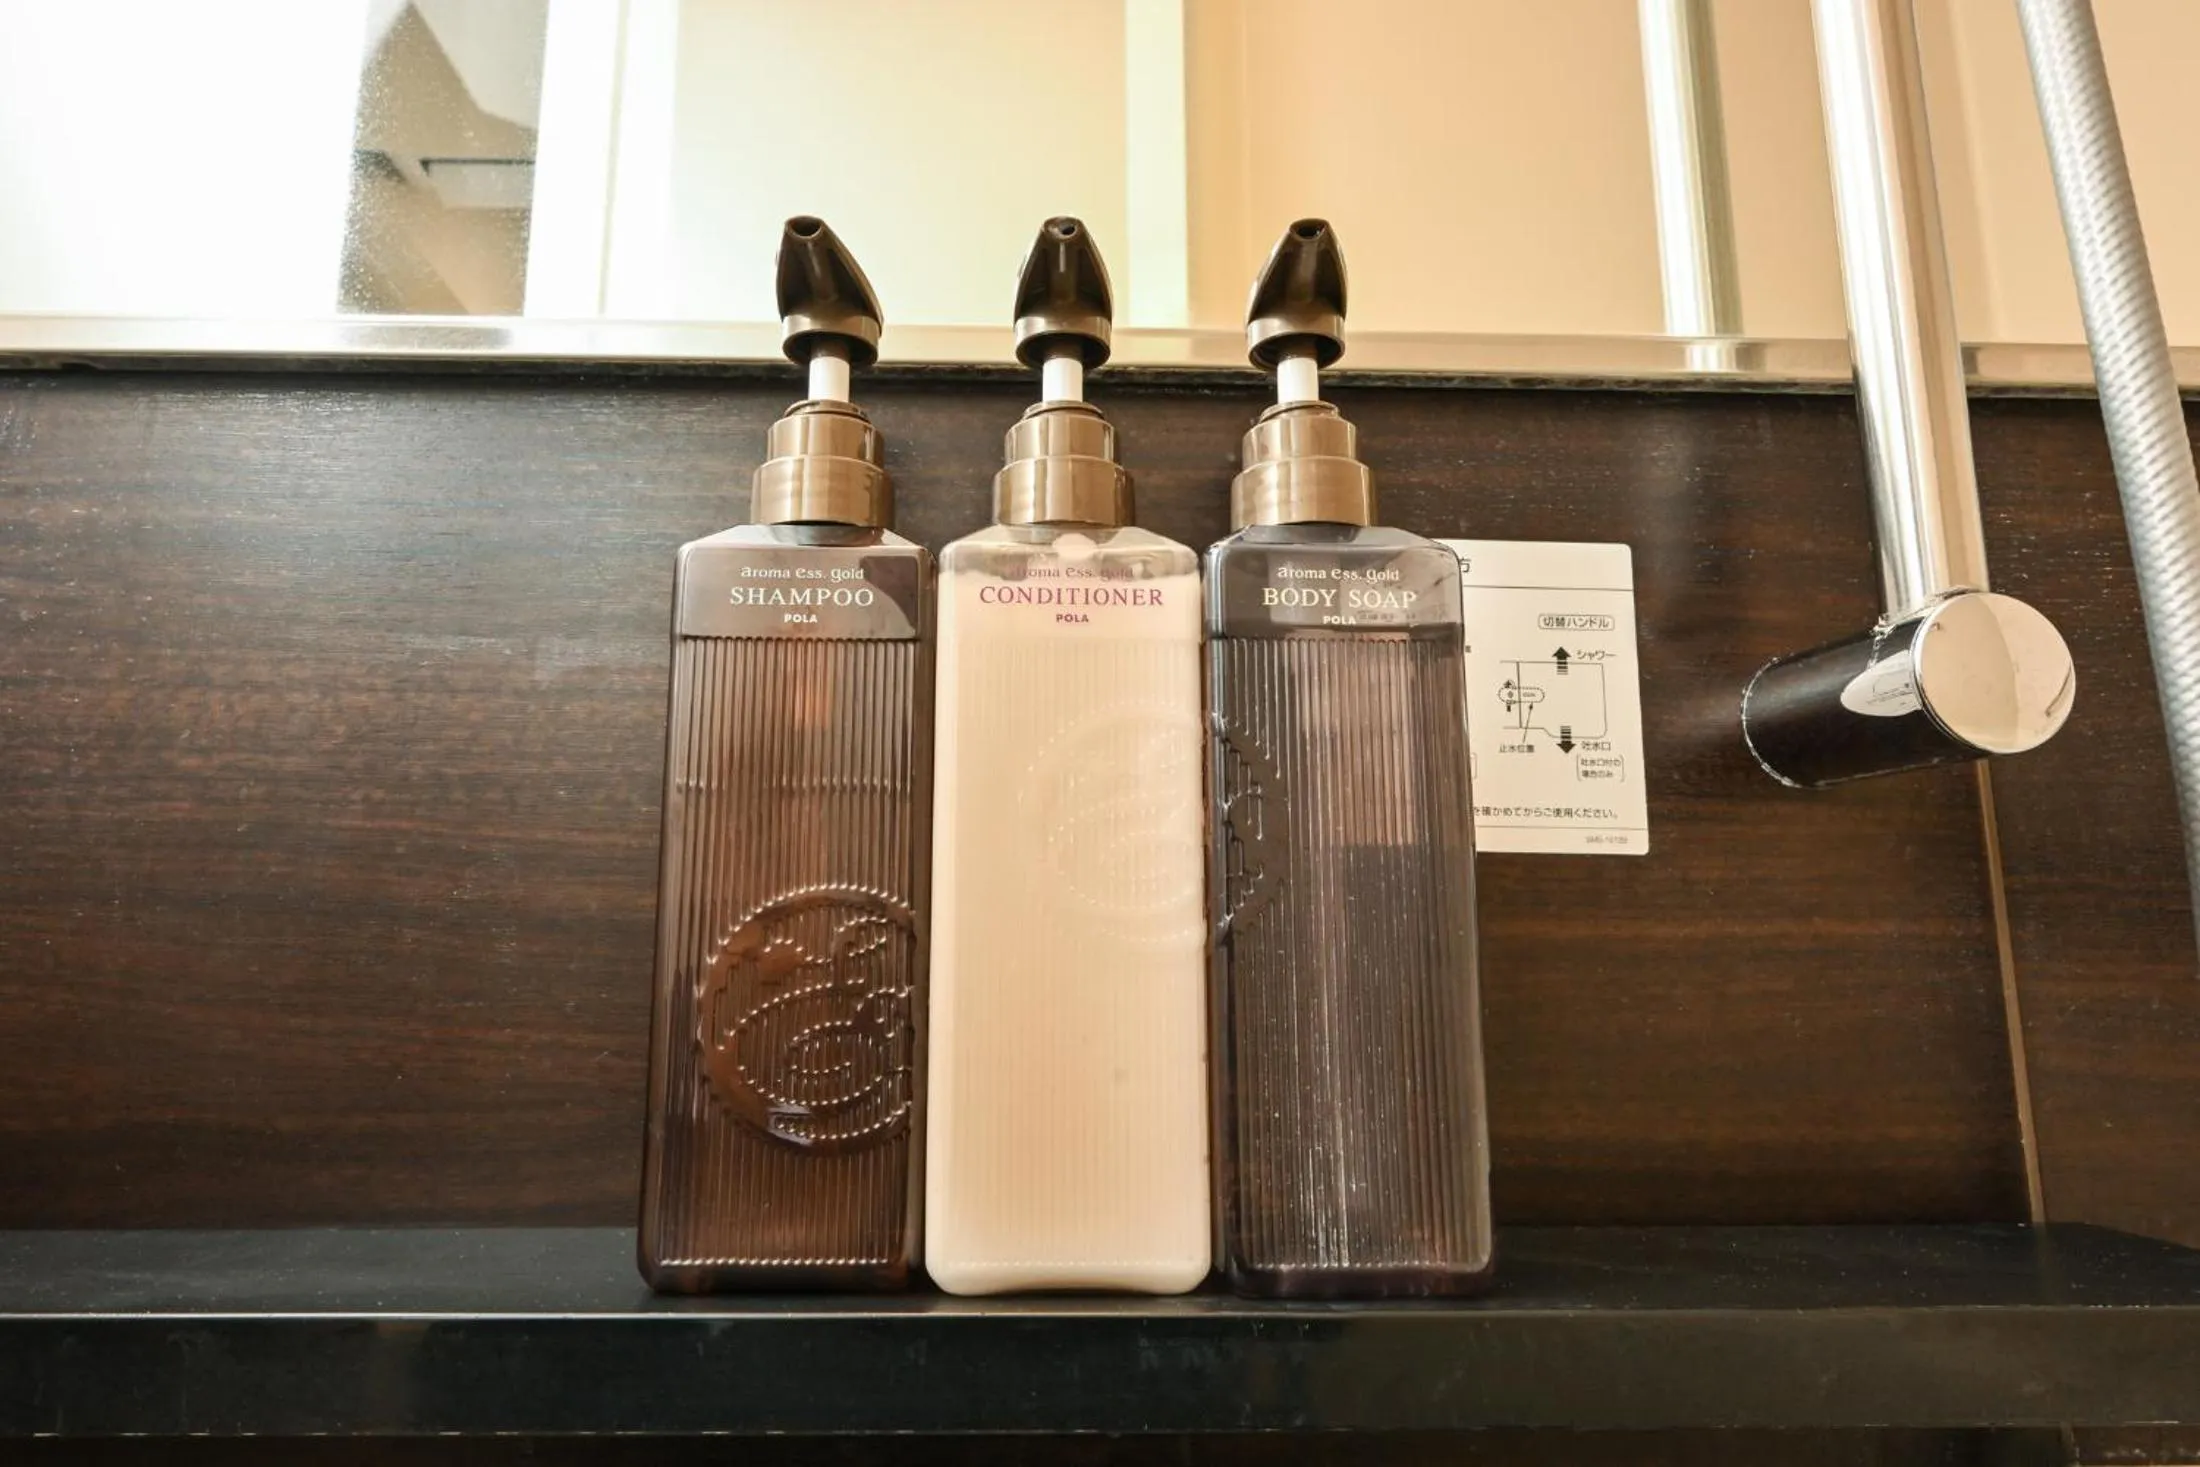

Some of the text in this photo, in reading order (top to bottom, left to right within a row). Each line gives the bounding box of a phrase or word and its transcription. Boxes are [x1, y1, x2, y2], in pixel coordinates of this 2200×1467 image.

[741, 566, 790, 579] aroma
[830, 567, 864, 583] gold
[1010, 566, 1060, 578] aroma
[1277, 567, 1326, 579] aroma
[1366, 569, 1399, 583] gold
[730, 586, 874, 607] SHAMPOO
[979, 586, 1164, 606] CONDITIONER
[1262, 587, 1418, 609] BODY SOAP
[783, 613, 818, 624] POLA
[1056, 614, 1089, 623] POLA
[1323, 615, 1357, 625] POLA
[1543, 616, 1610, 629] 切替ハンドル
[1576, 650, 1617, 661] シャワー
